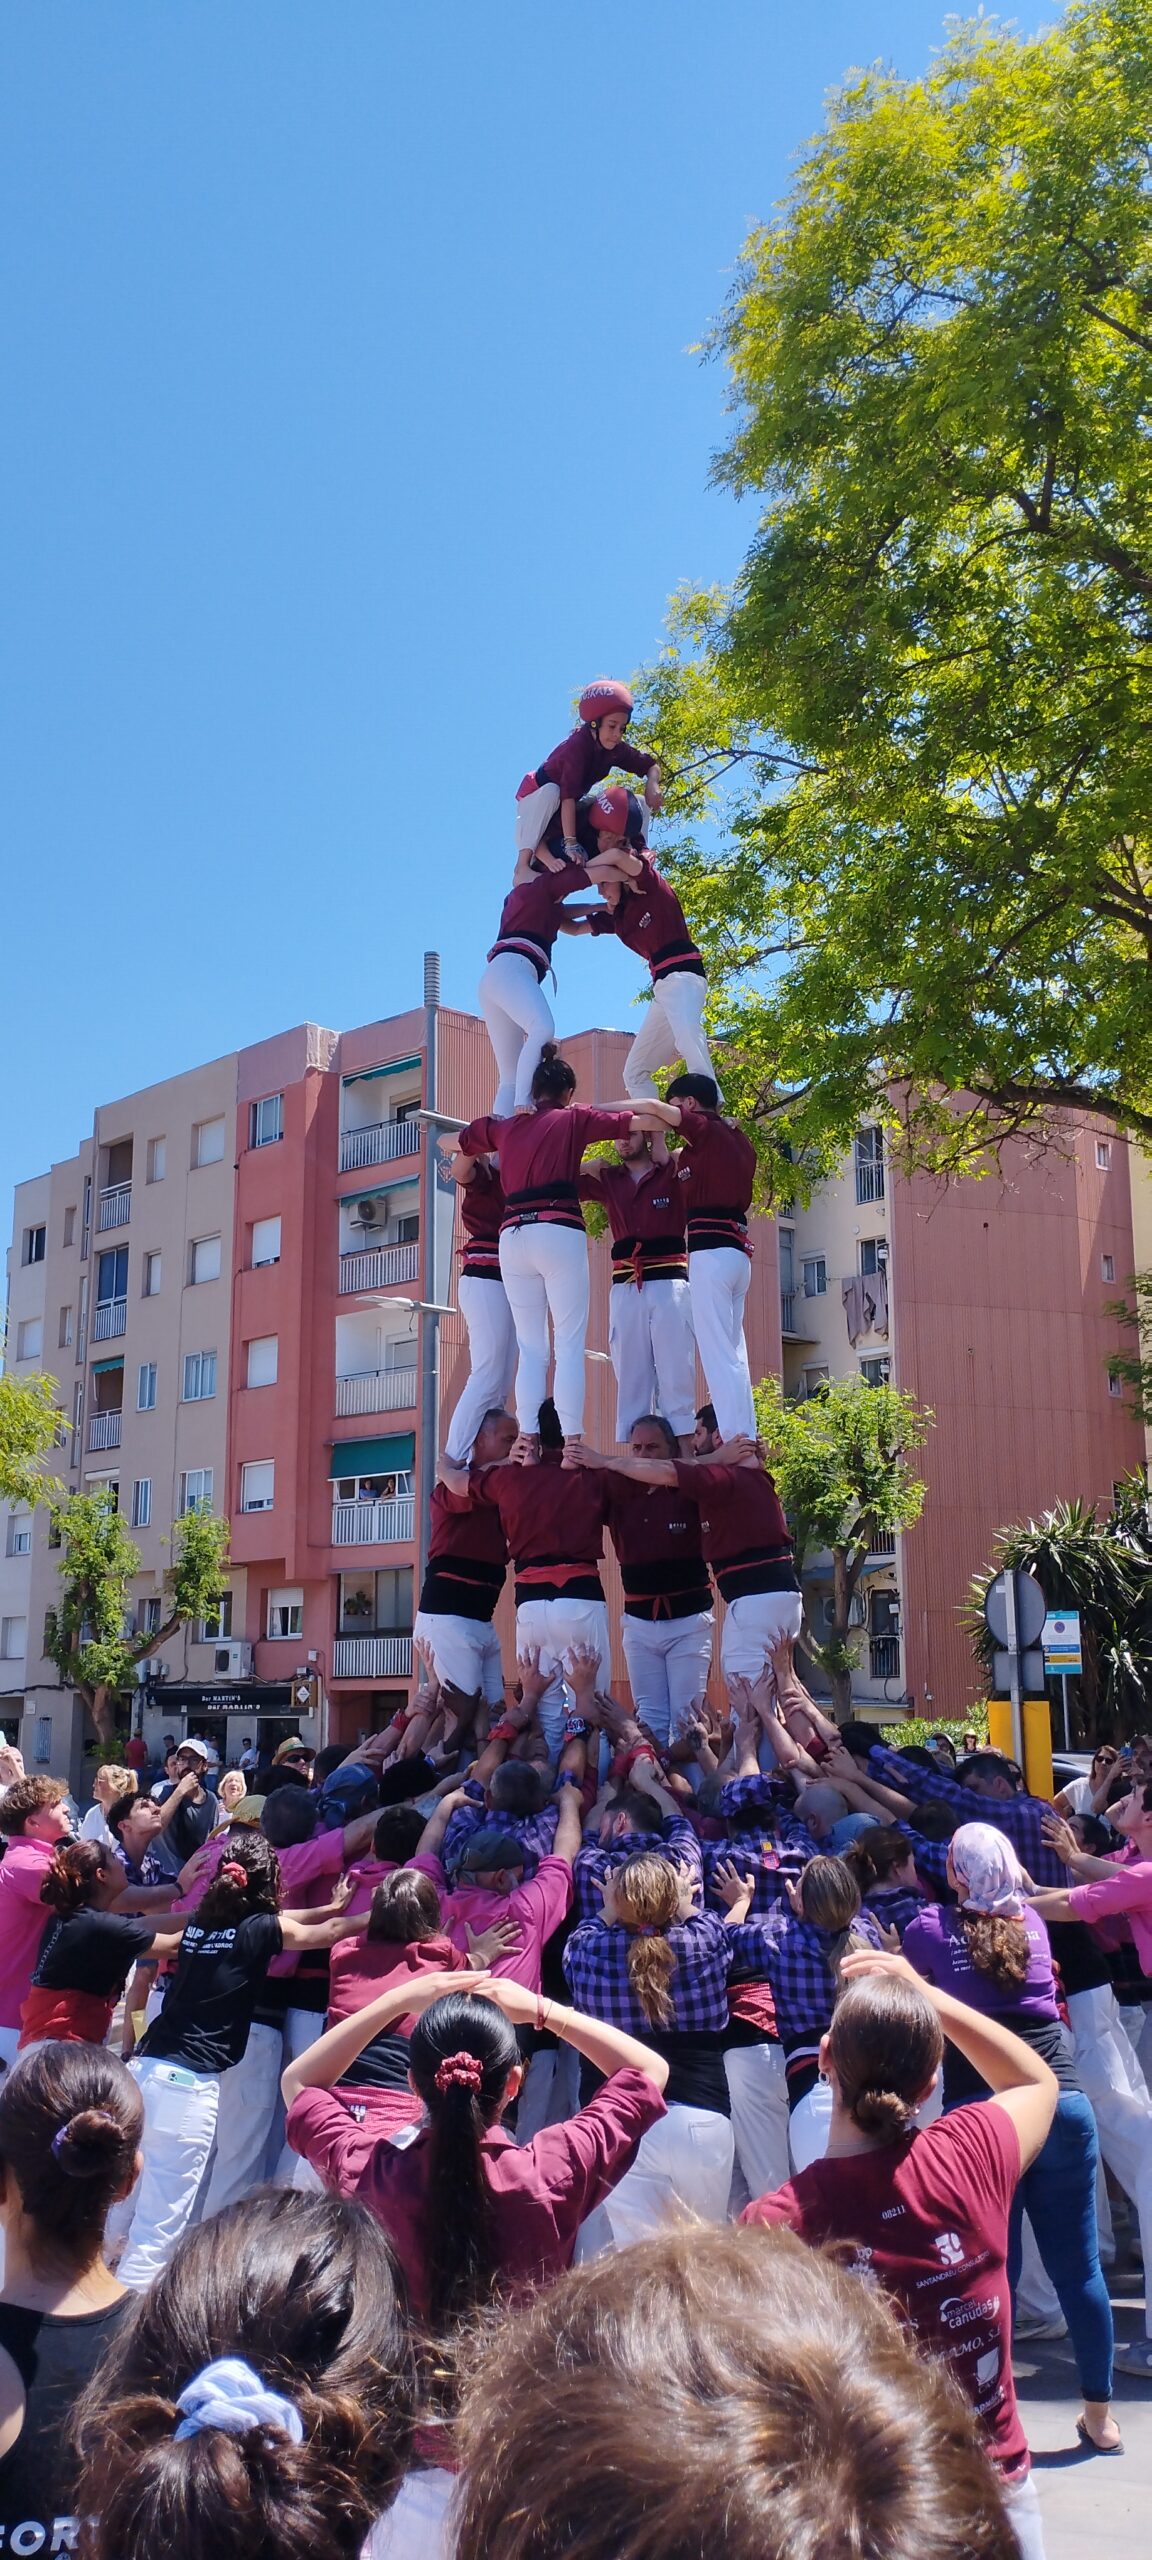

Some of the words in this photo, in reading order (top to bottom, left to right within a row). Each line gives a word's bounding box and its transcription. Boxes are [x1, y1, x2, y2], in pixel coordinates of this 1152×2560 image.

[881, 2204, 906, 2220] 08211
[946, 2298, 978, 2317] marcel
[948, 2299, 994, 2329] canudas
